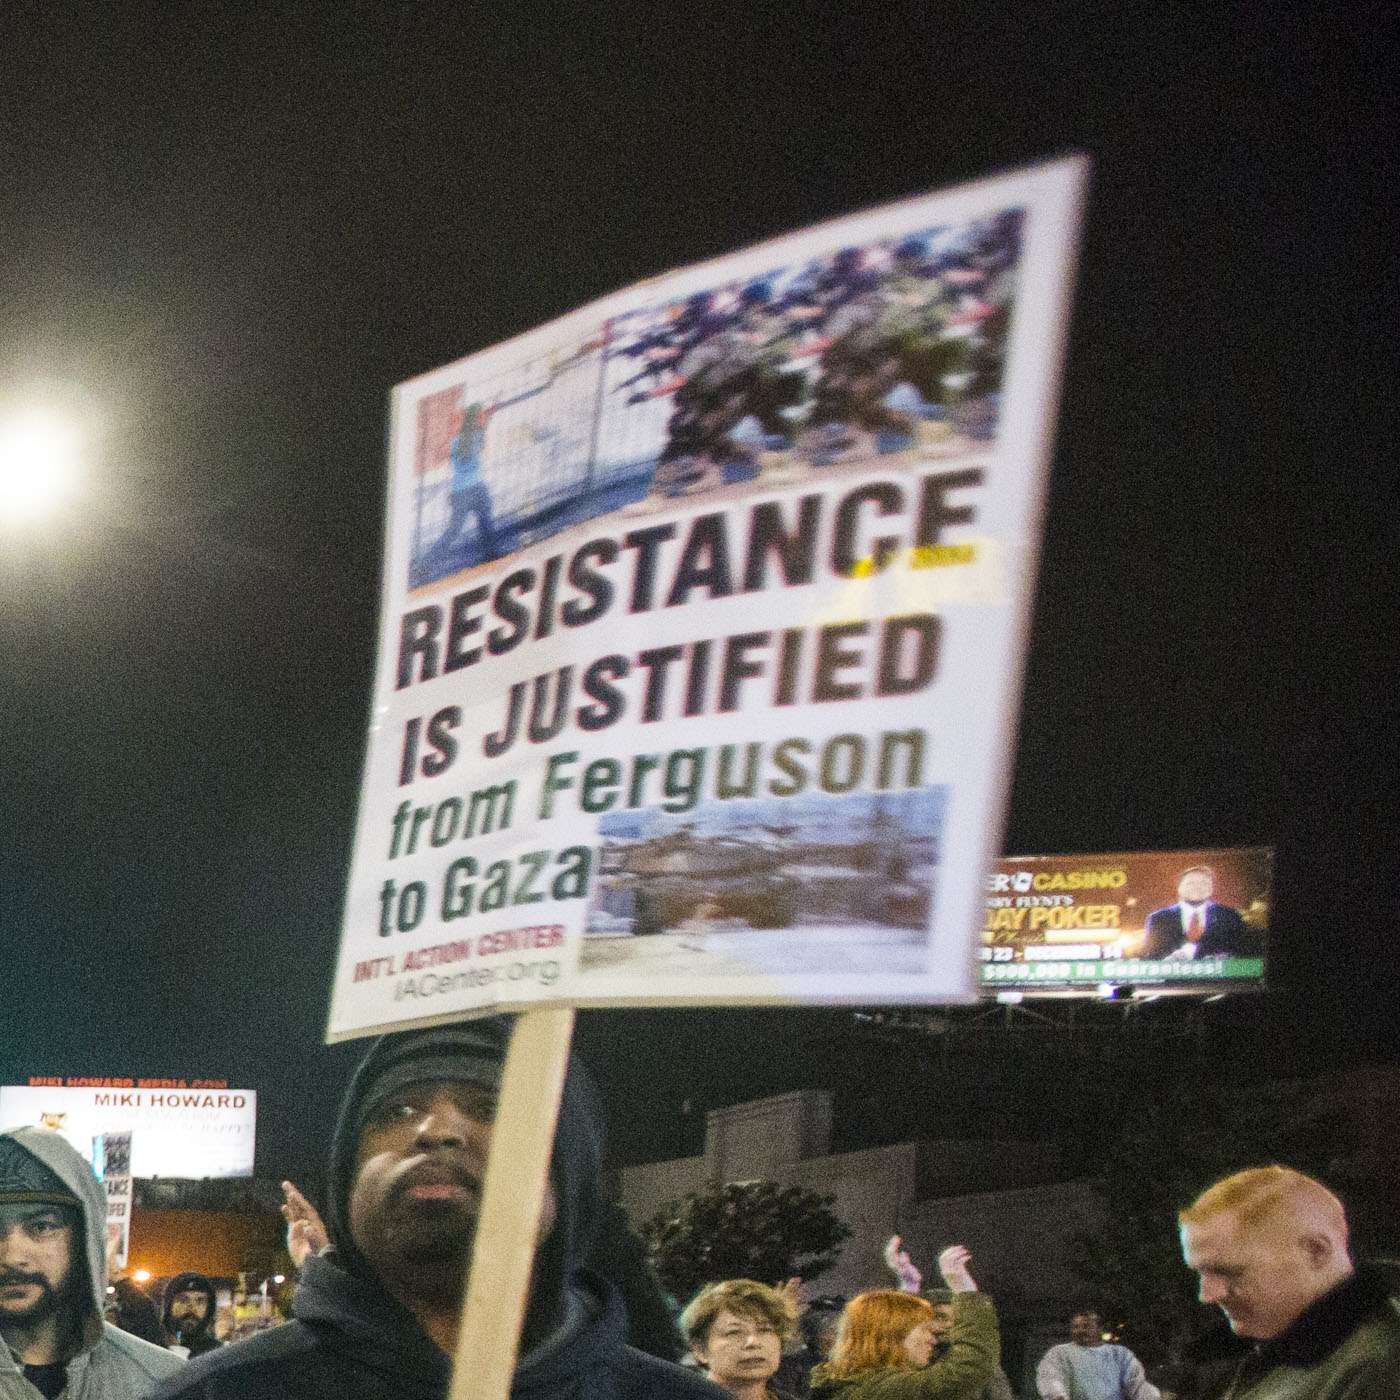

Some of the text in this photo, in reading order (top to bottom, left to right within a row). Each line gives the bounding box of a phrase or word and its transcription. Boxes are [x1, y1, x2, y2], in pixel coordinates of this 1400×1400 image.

[394, 466, 986, 690] RESISTANCE
[397, 612, 944, 786] IS JUSTIFIED
[386, 726, 929, 861] from Ferguson
[378, 844, 594, 938] to Gaza
[1033, 870, 1129, 891] CASINO
[402, 939, 469, 972] ACTION
[477, 923, 566, 957] CENTER
[1029, 904, 1121, 929] POKER
[94, 1093, 247, 1109] MIKI HOWARD
